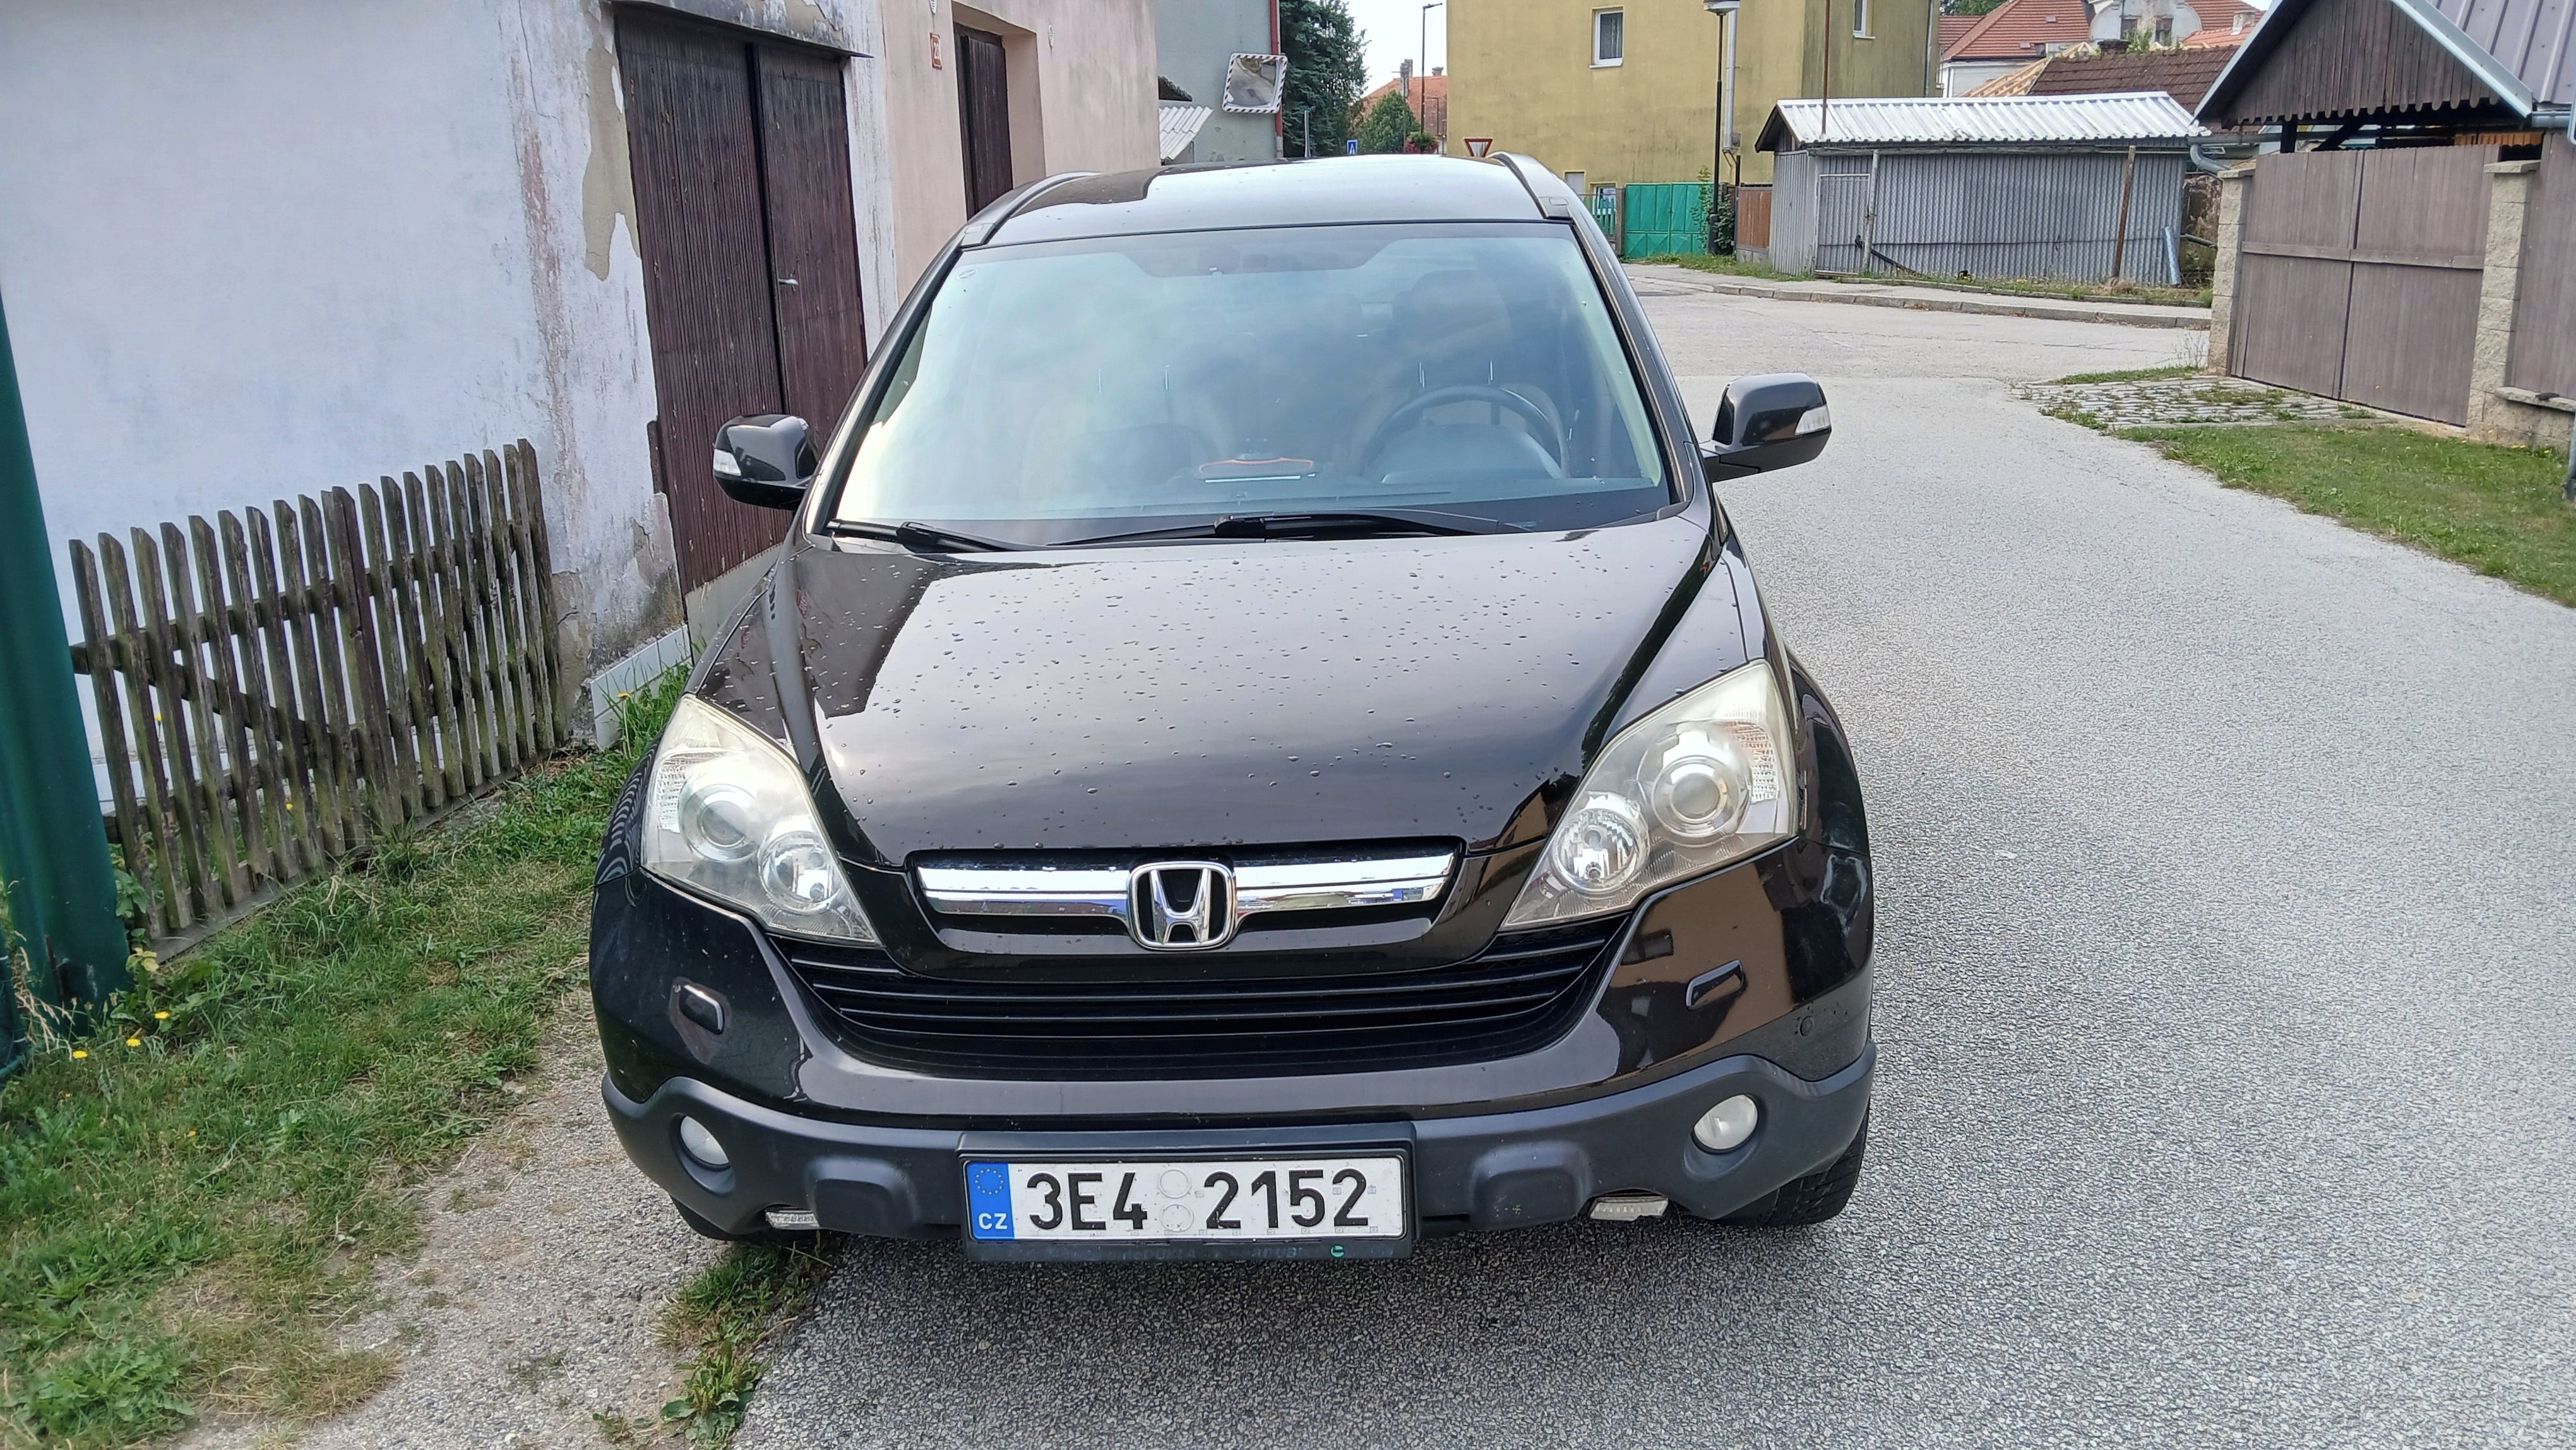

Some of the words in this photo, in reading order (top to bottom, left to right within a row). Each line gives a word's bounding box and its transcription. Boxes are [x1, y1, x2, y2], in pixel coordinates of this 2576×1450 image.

[1027, 1171, 1148, 1230] 3E4
[1204, 1169, 1369, 1229] 2152
[978, 1213, 1008, 1230] CZ
